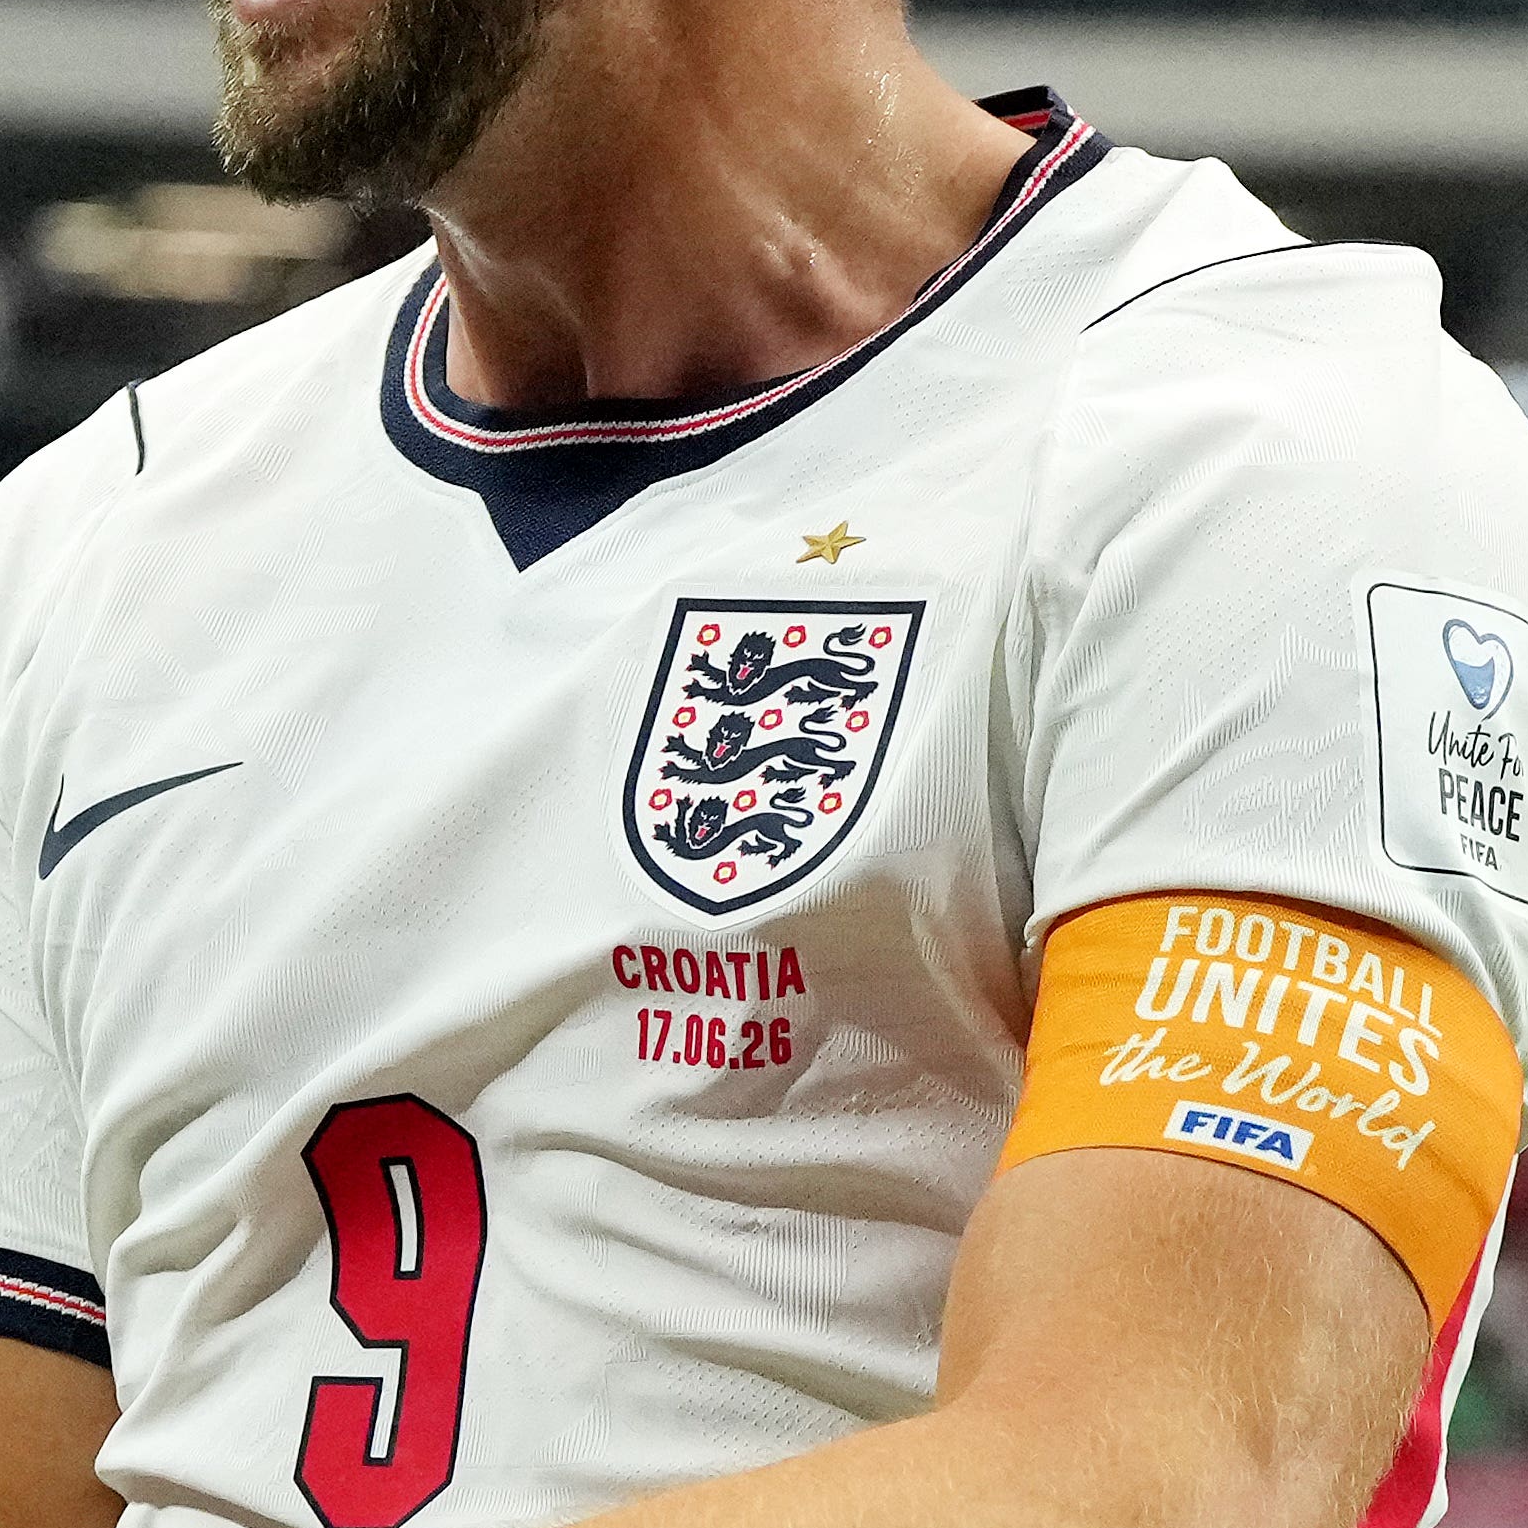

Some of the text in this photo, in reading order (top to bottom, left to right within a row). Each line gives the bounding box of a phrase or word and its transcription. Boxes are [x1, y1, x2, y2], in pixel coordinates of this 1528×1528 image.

[1428, 710, 1494, 768] Unite
[1438, 768, 1524, 842] PEACE
[1460, 833, 1498, 871] FIFA
[612, 945, 806, 1002] CROATIA
[1158, 905, 1441, 1037] FOOTBALL
[637, 1008, 792, 1070] 17.06.26
[1135, 957, 1440, 1097] UNITES
[1099, 1027, 1436, 1171] the World
[1180, 1109, 1294, 1162] FIFA
